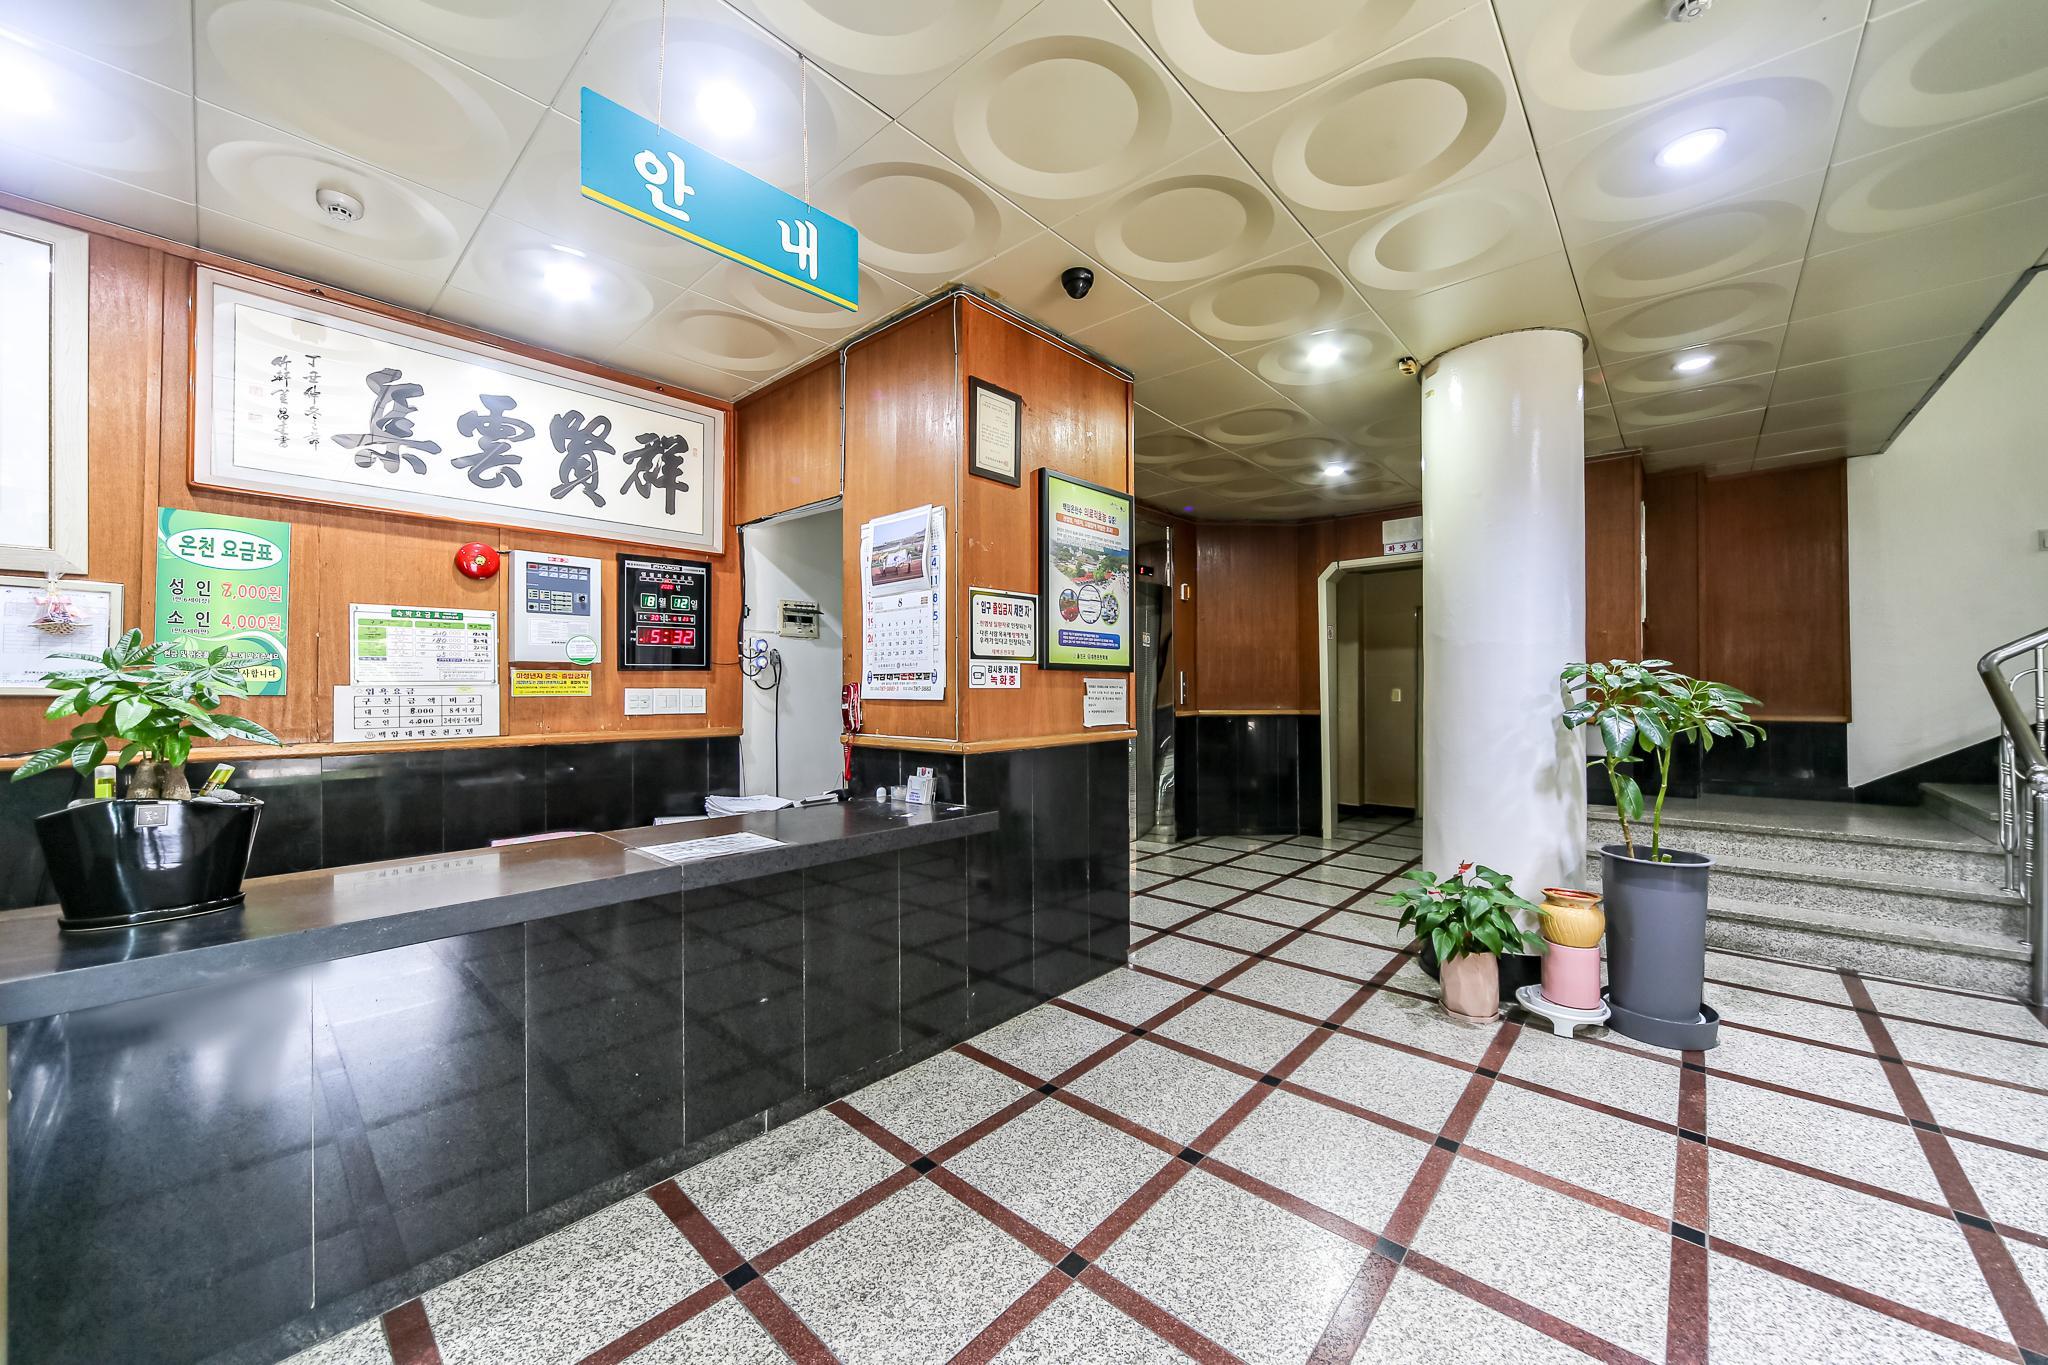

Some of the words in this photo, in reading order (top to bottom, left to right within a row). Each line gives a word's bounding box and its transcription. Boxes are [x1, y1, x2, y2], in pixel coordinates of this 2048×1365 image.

[178, 535, 214, 558] 온천
[220, 540, 274, 562] 요금표
[1388, 542, 1418, 552] 화장실
[658, 598, 666, 608] 월
[690, 600, 698, 610] 일
[992, 602, 1013, 616] 출입금지
[1013, 604, 1024, 618] 제한
[221, 614, 281, 632] 4,000원
[650, 630, 694, 644] 5:32
[987, 665, 1002, 674] 감시용
